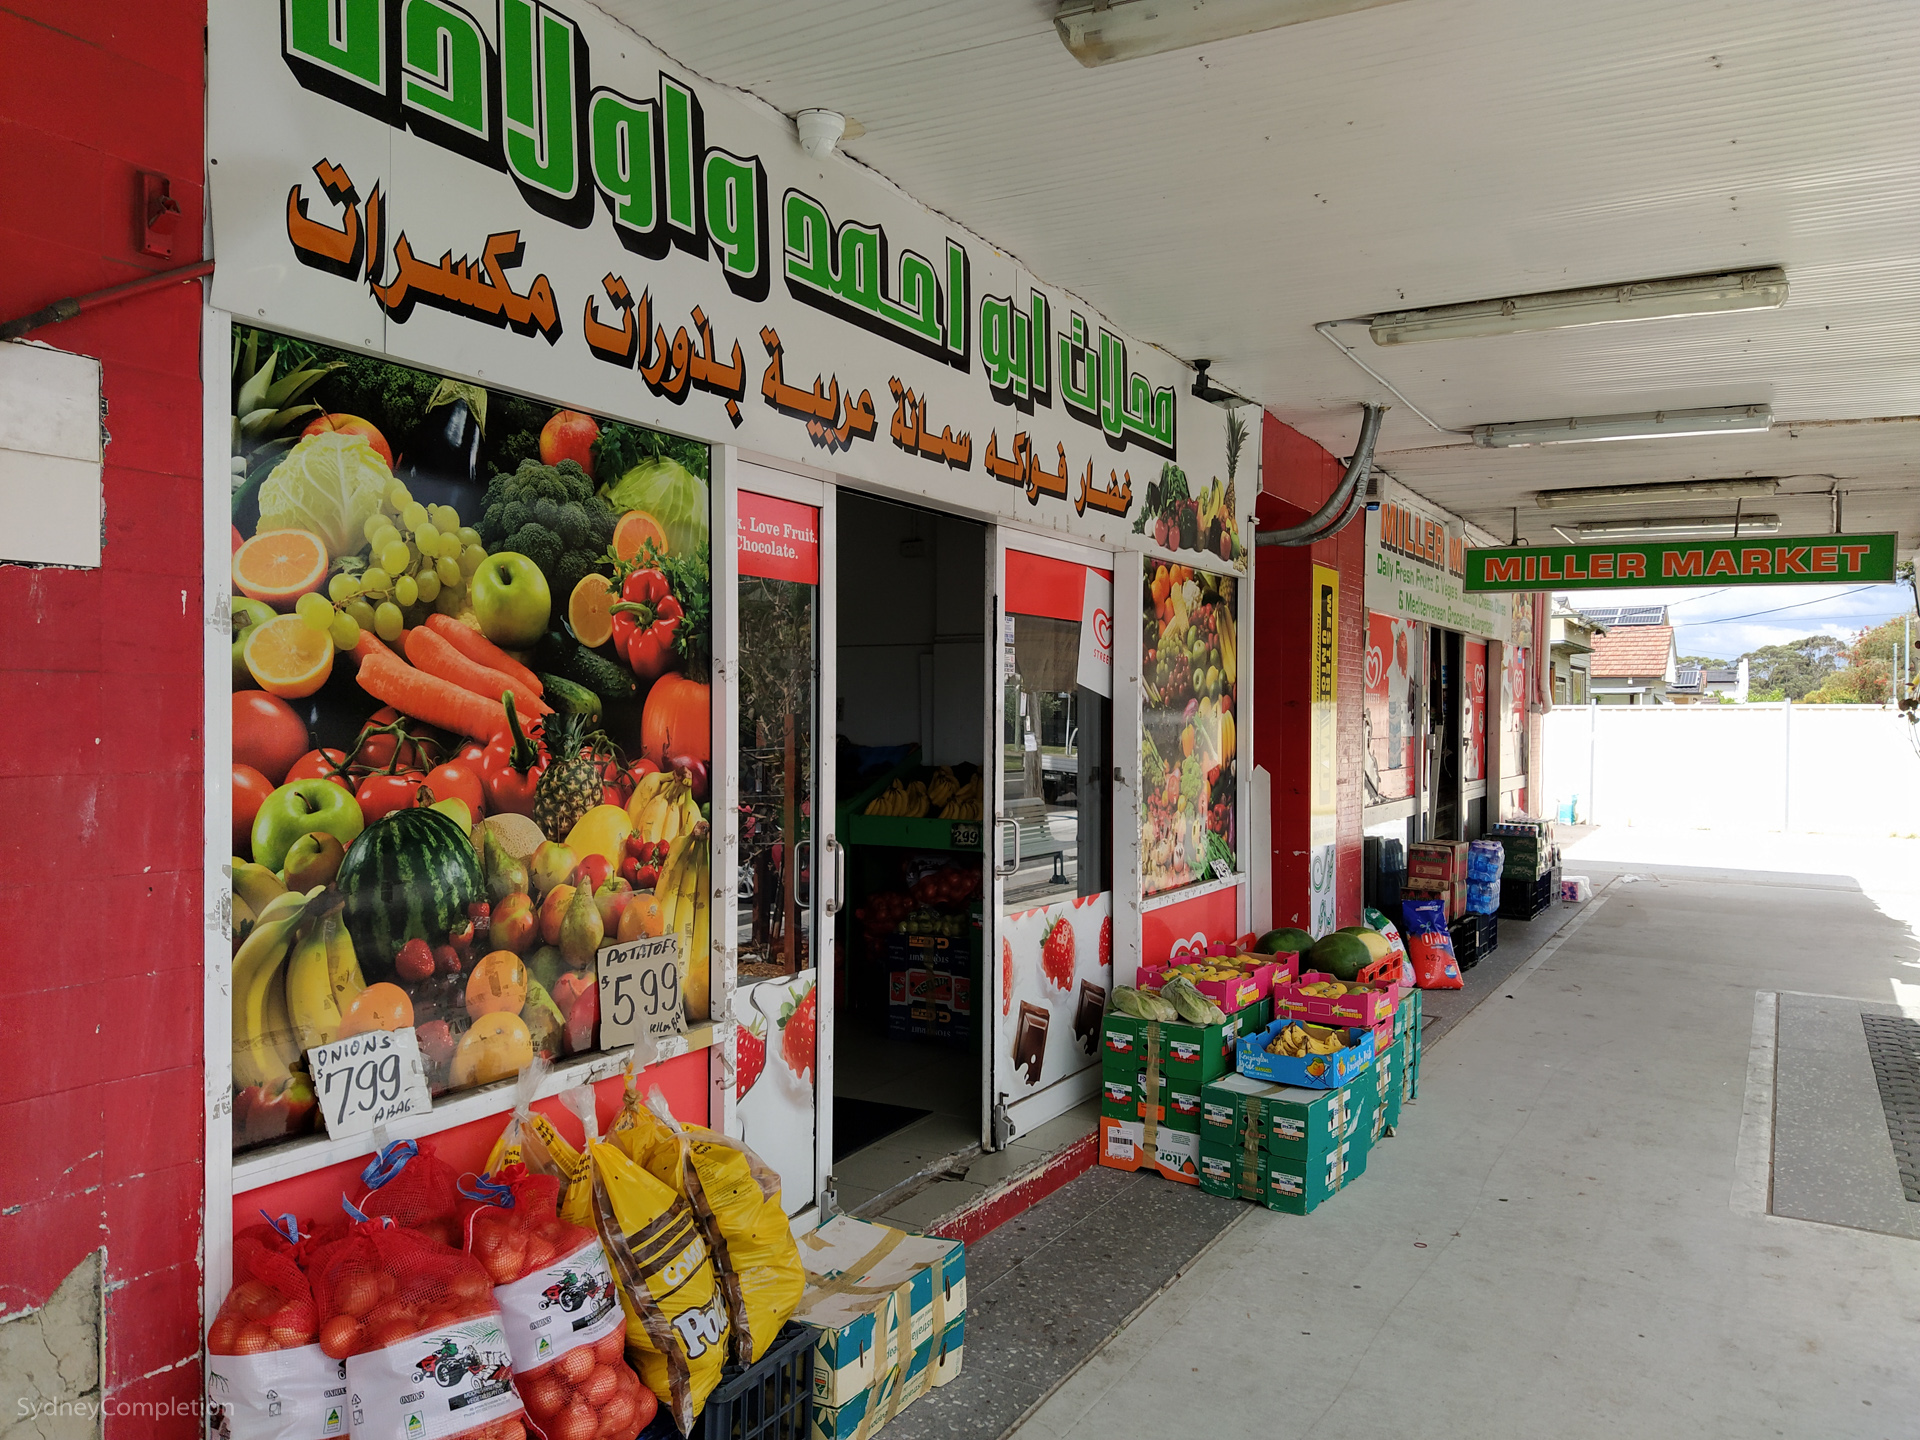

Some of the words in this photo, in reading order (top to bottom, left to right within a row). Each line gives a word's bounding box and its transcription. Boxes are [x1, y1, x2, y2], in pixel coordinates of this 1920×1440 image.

[286, 156, 563, 347] مكسرات
[783, 187, 971, 374] احمد
[980, 286, 1052, 416] ابو
[760, 324, 878, 455] عربية
[1057, 309, 1176, 461] محلات
[984, 427, 1068, 504] فواكه
[1073, 455, 1134, 518] خضار
[736, 535, 799, 560] Chocolate.
[749, 517, 780, 536] Love
[783, 523, 818, 543] Fruit.
[1380, 501, 1445, 572] MILLER
[1377, 553, 1394, 583] Daily
[1395, 560, 1415, 586] Fresh
[1416, 568, 1434, 592] Fruits
[1484, 552, 1647, 584] MILLER
[1662, 544, 1871, 576] MARKET
[318, 1036, 392, 1067] ONIONS
[529, 1316, 552, 1331] ONIONS
[399, 1390, 426, 1405] ONIONS
